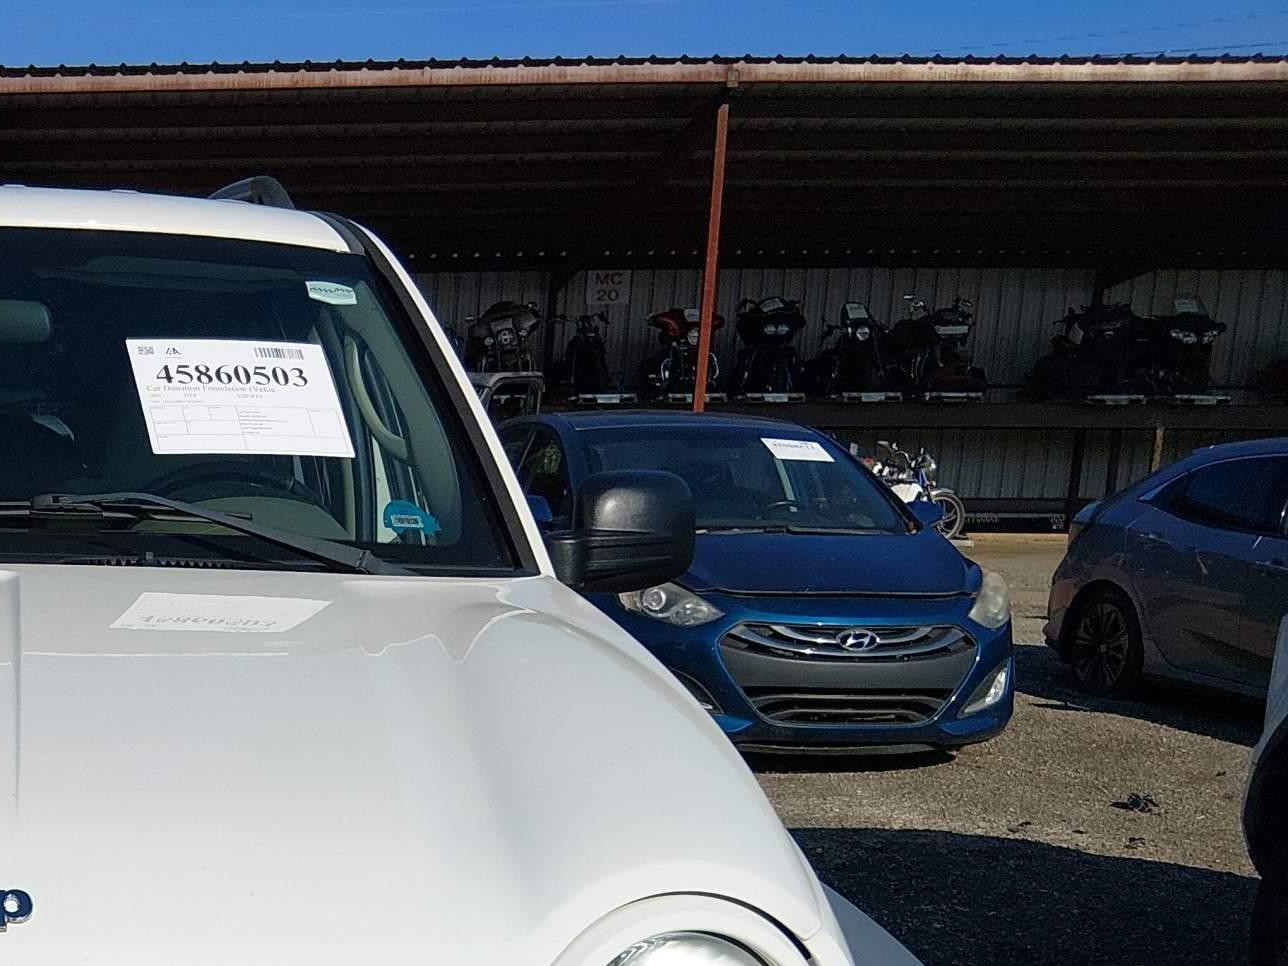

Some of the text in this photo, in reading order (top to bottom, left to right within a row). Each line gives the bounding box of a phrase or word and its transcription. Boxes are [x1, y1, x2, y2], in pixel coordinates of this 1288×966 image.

[595, 272, 623, 285] MC
[597, 289, 619, 301] 20
[156, 364, 308, 387] 45860503
[202, 385, 247, 393] Foundation
